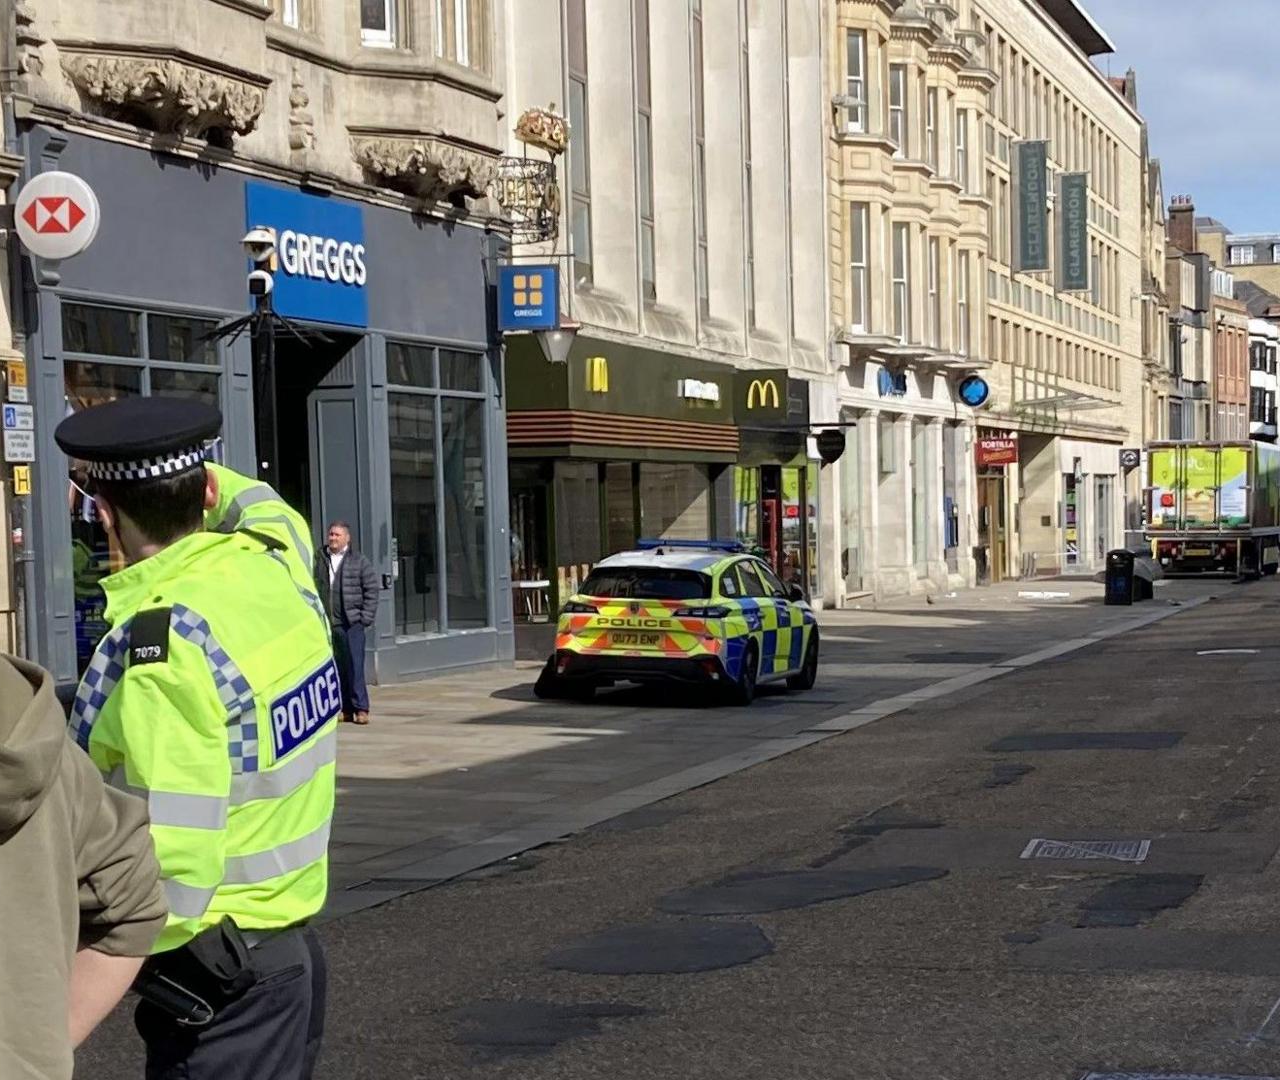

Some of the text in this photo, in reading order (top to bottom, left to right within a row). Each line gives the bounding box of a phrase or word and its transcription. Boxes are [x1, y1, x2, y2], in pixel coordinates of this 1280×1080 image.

[1069, 187, 1081, 278] CLARENDON
[280, 230, 367, 286] GREGGS
[514, 308, 543, 317] GREGGS
[981, 440, 1014, 449] TORTILLA
[596, 617, 672, 628] POLICE
[134, 645, 161, 659] 7079
[272, 666, 340, 750] POLICE
